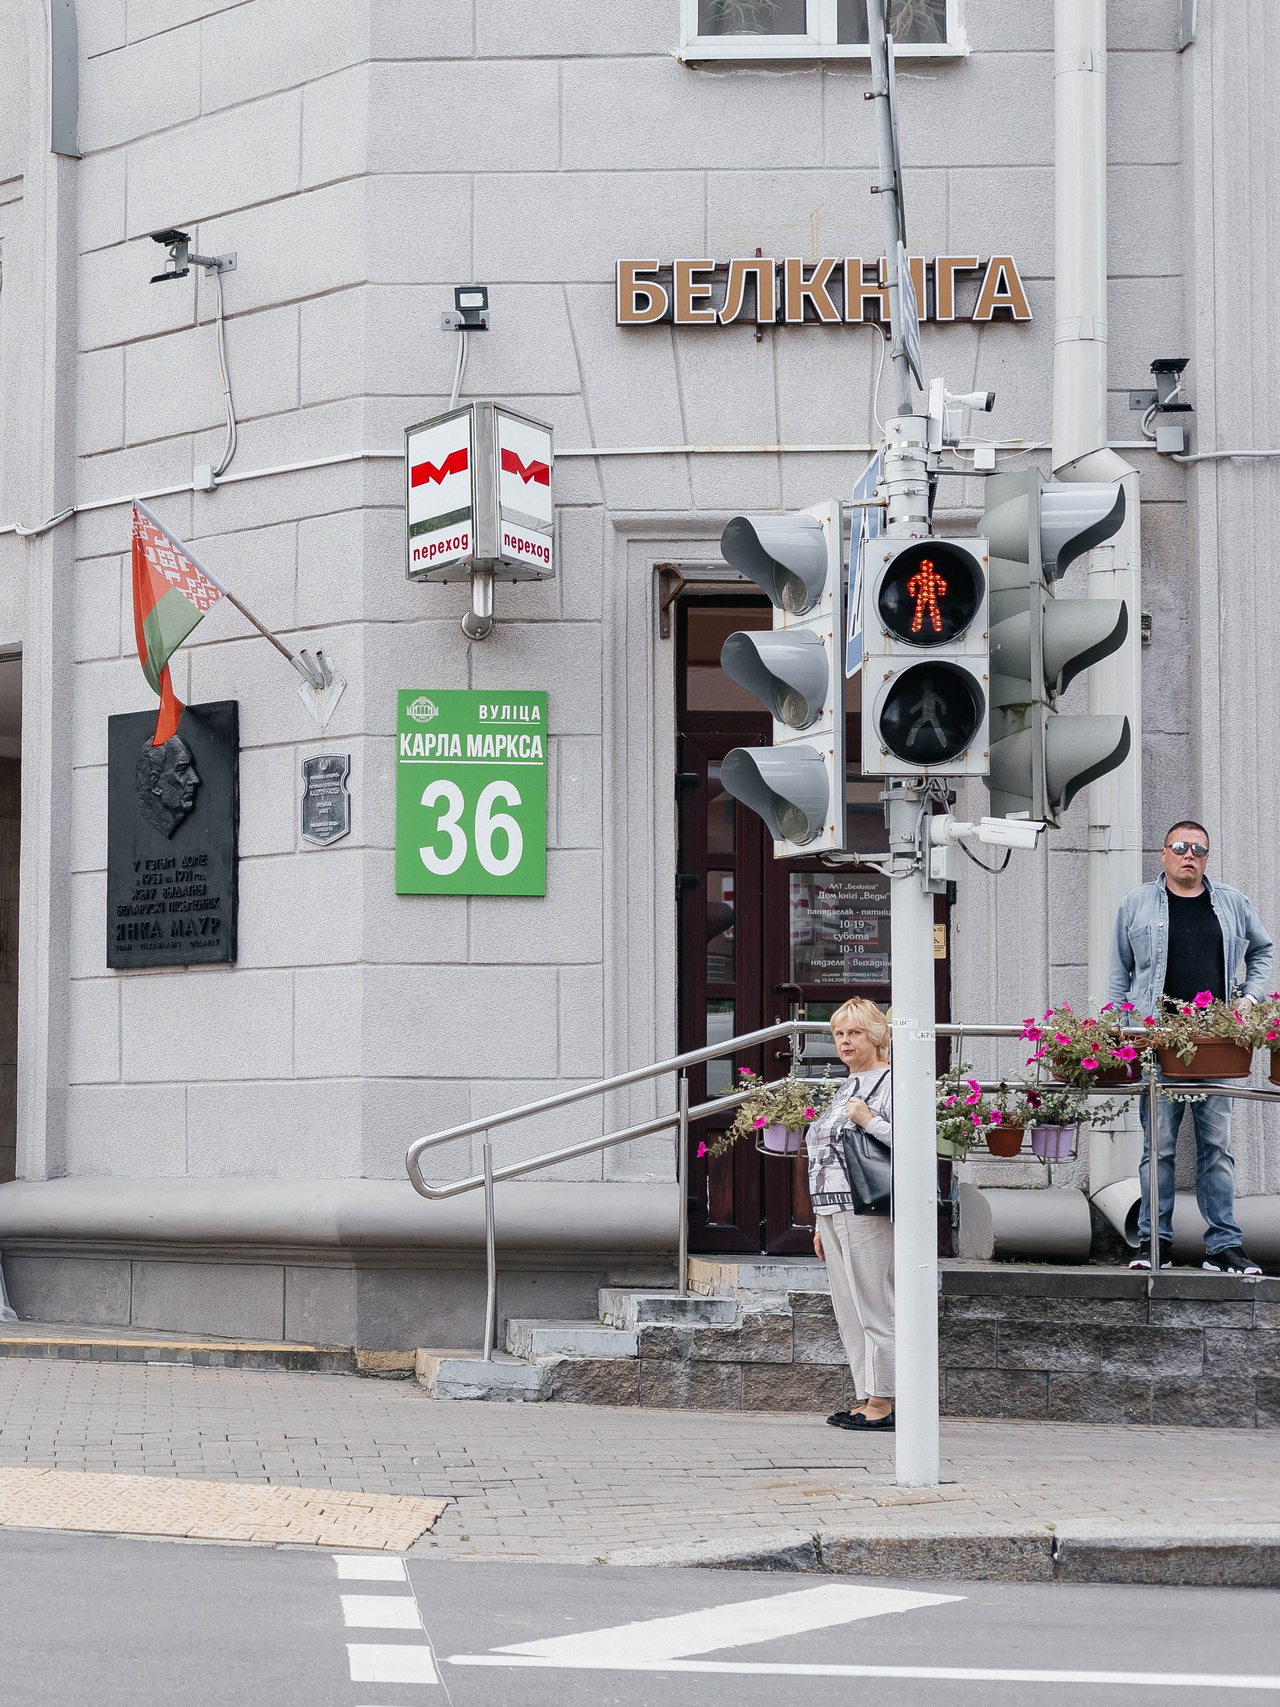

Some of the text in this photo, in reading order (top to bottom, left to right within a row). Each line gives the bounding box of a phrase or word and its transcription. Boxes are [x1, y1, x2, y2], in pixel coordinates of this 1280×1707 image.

[616, 255, 1033, 325] БЕЛКНІГА
[413, 533, 469, 561] переход
[504, 533, 550, 563] переход
[478, 704, 541, 721] ВУЛІЦА
[400, 732, 543, 758] КАРЛА МАРКСА
[419, 779, 524, 877] 36
[146, 857, 176, 870] ГЭТЫМ
[181, 854, 208, 868] ДОМЕ
[818, 892, 837, 900] Дом
[116, 920, 163, 942] ЯНКА
[840, 920, 865, 928] 10-19
[833, 932, 870, 941] субота
[839, 944, 864, 953] 10-18
[810, 960, 845, 968] нядзеля
